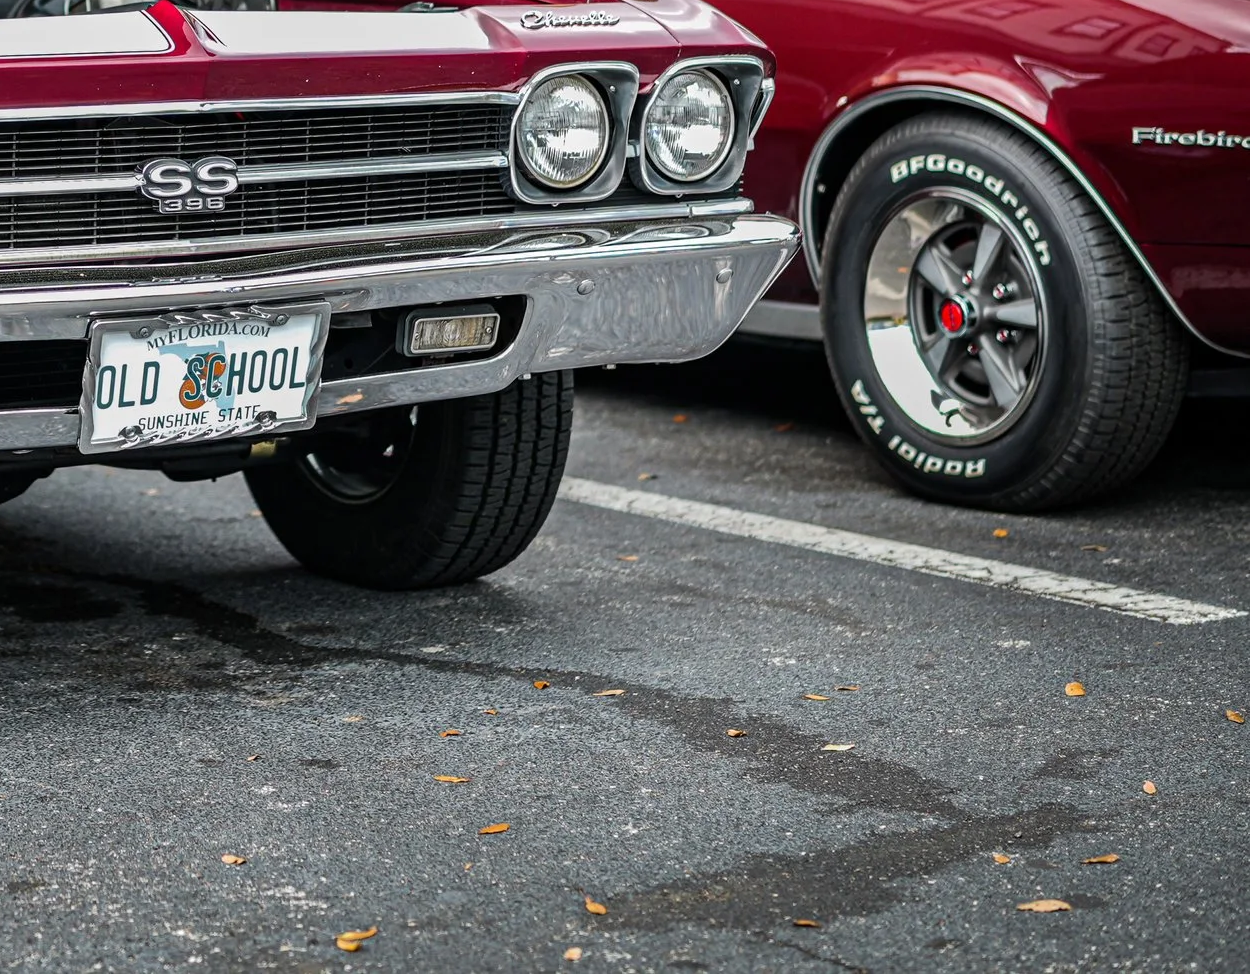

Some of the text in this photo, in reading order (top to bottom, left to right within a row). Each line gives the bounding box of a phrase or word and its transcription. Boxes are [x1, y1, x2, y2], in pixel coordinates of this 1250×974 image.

[520, 10, 621, 30] Chevelle
[148, 162, 238, 198] SS
[163, 196, 224, 212] 396
[890, 154, 1052, 266] BFGoodrich
[146, 322, 271, 351] MYFLORIDA.COM
[97, 346, 306, 410] OLD SCHOOL
[139, 405, 261, 431] SUNSHINE STATE
[850, 378, 987, 479] Radial T/A
